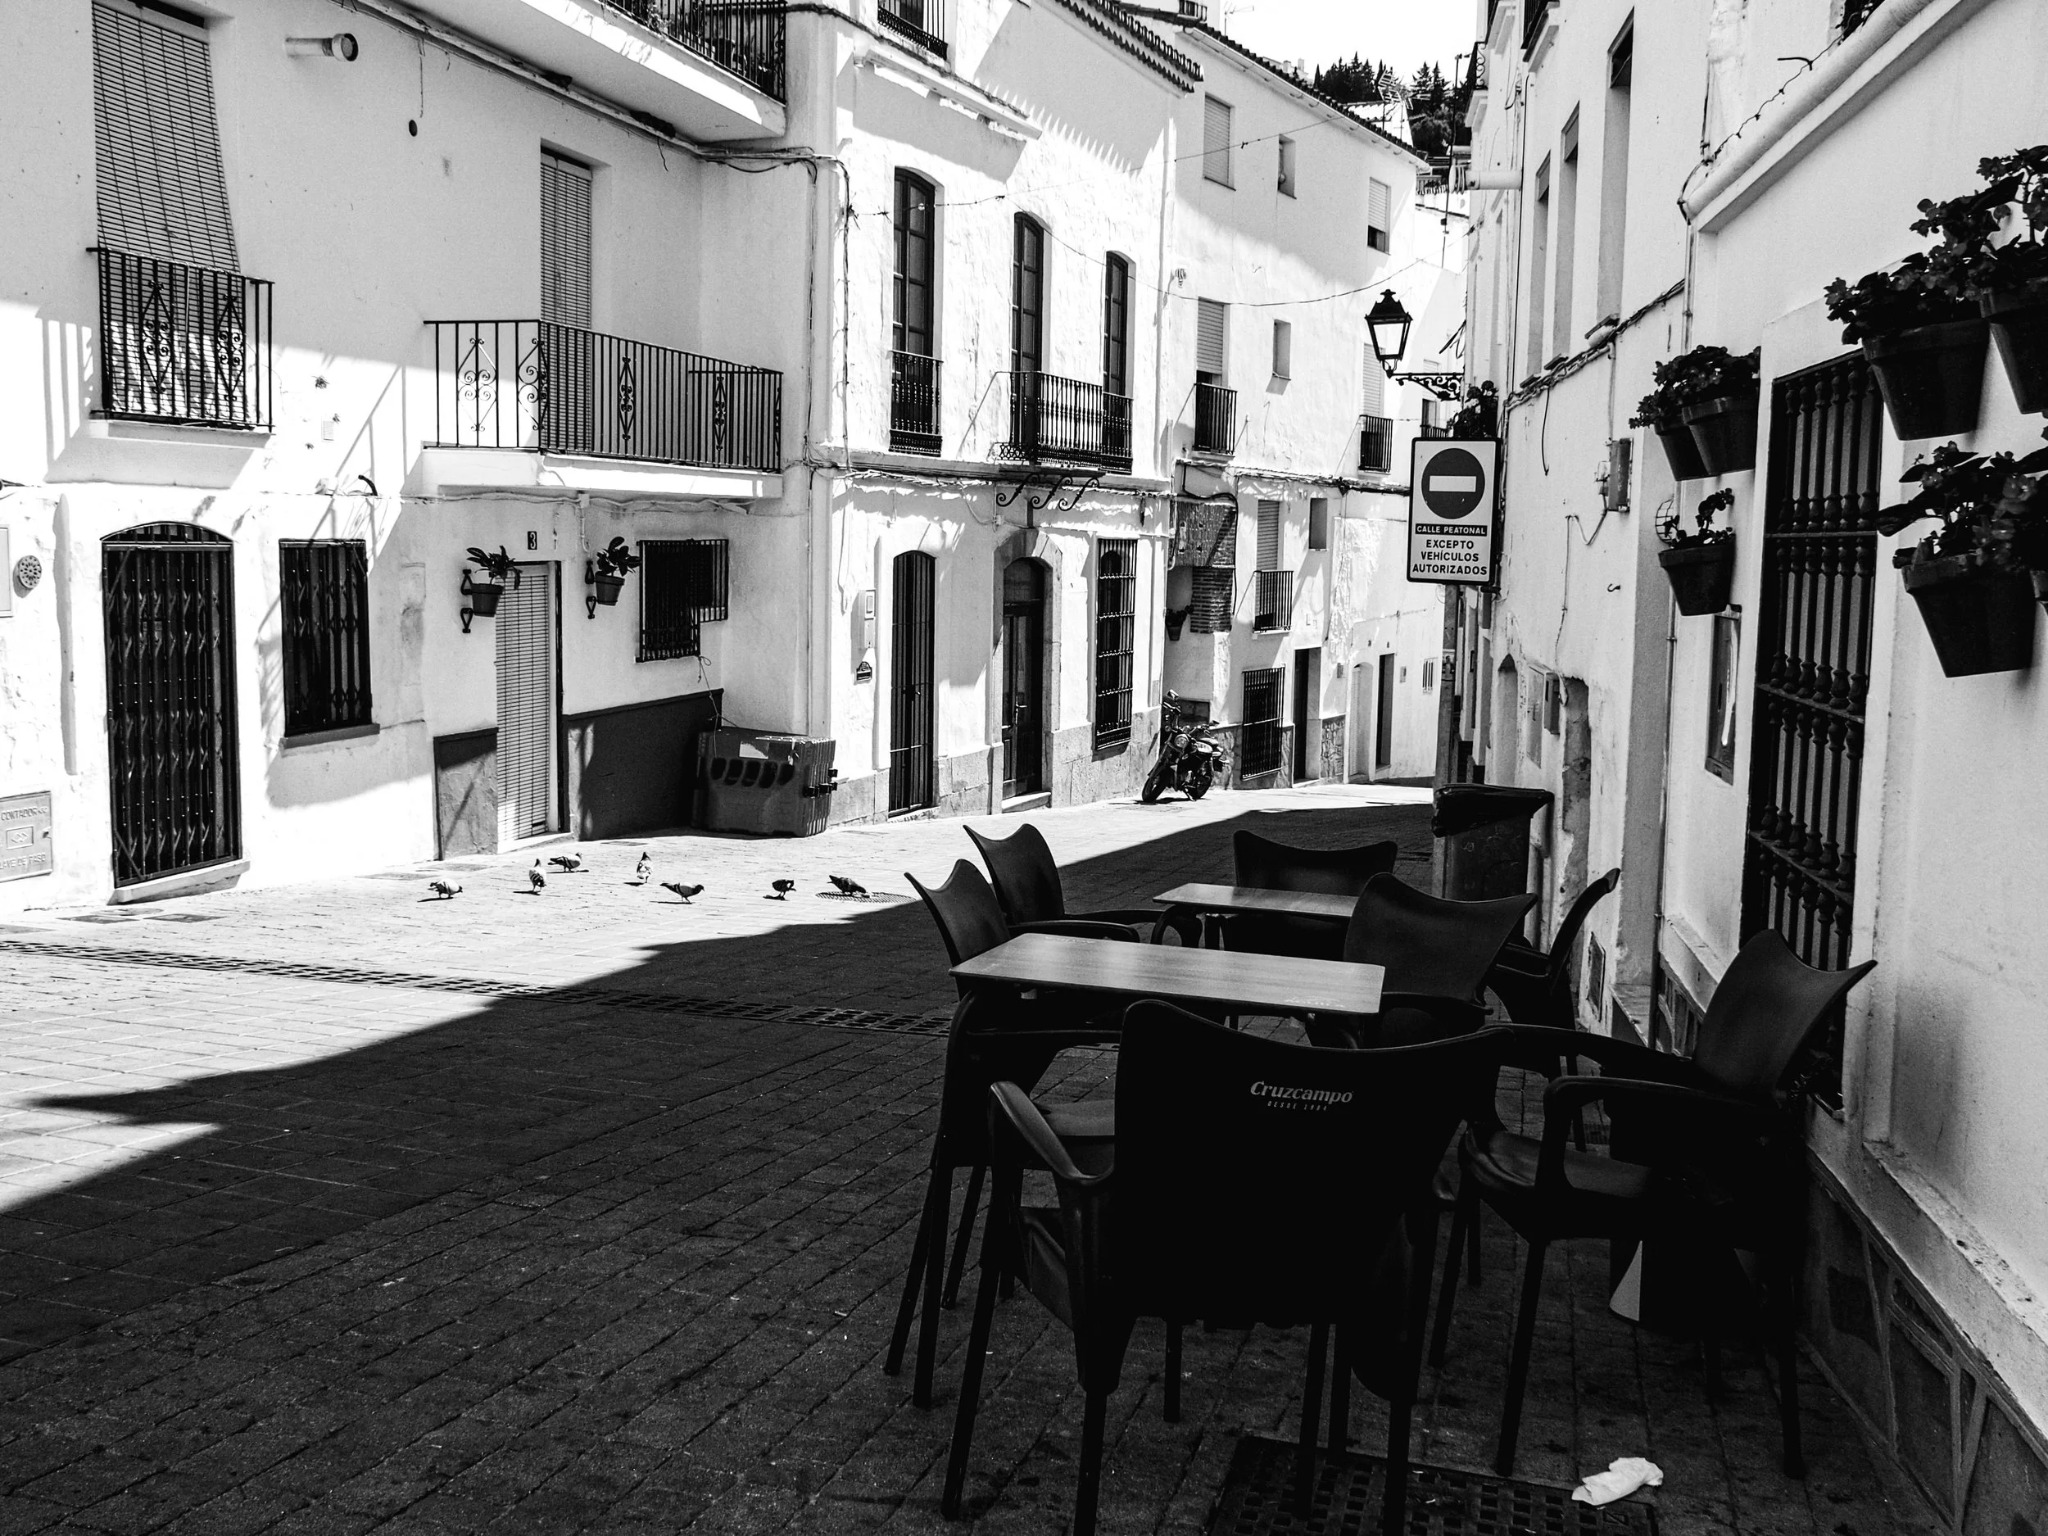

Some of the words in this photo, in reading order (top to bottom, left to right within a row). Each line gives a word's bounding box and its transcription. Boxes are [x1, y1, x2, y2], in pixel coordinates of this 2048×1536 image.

[1416, 525, 1440, 533] CALLE
[1443, 526, 1485, 535] PEATONAL
[1426, 539, 1474, 549] EXCEPTO
[1421, 550, 1479, 562] VEHÍCULOS
[1412, 564, 1487, 575] AUTORIZADOS
[1250, 1081, 1353, 1104] Cruzcampo
